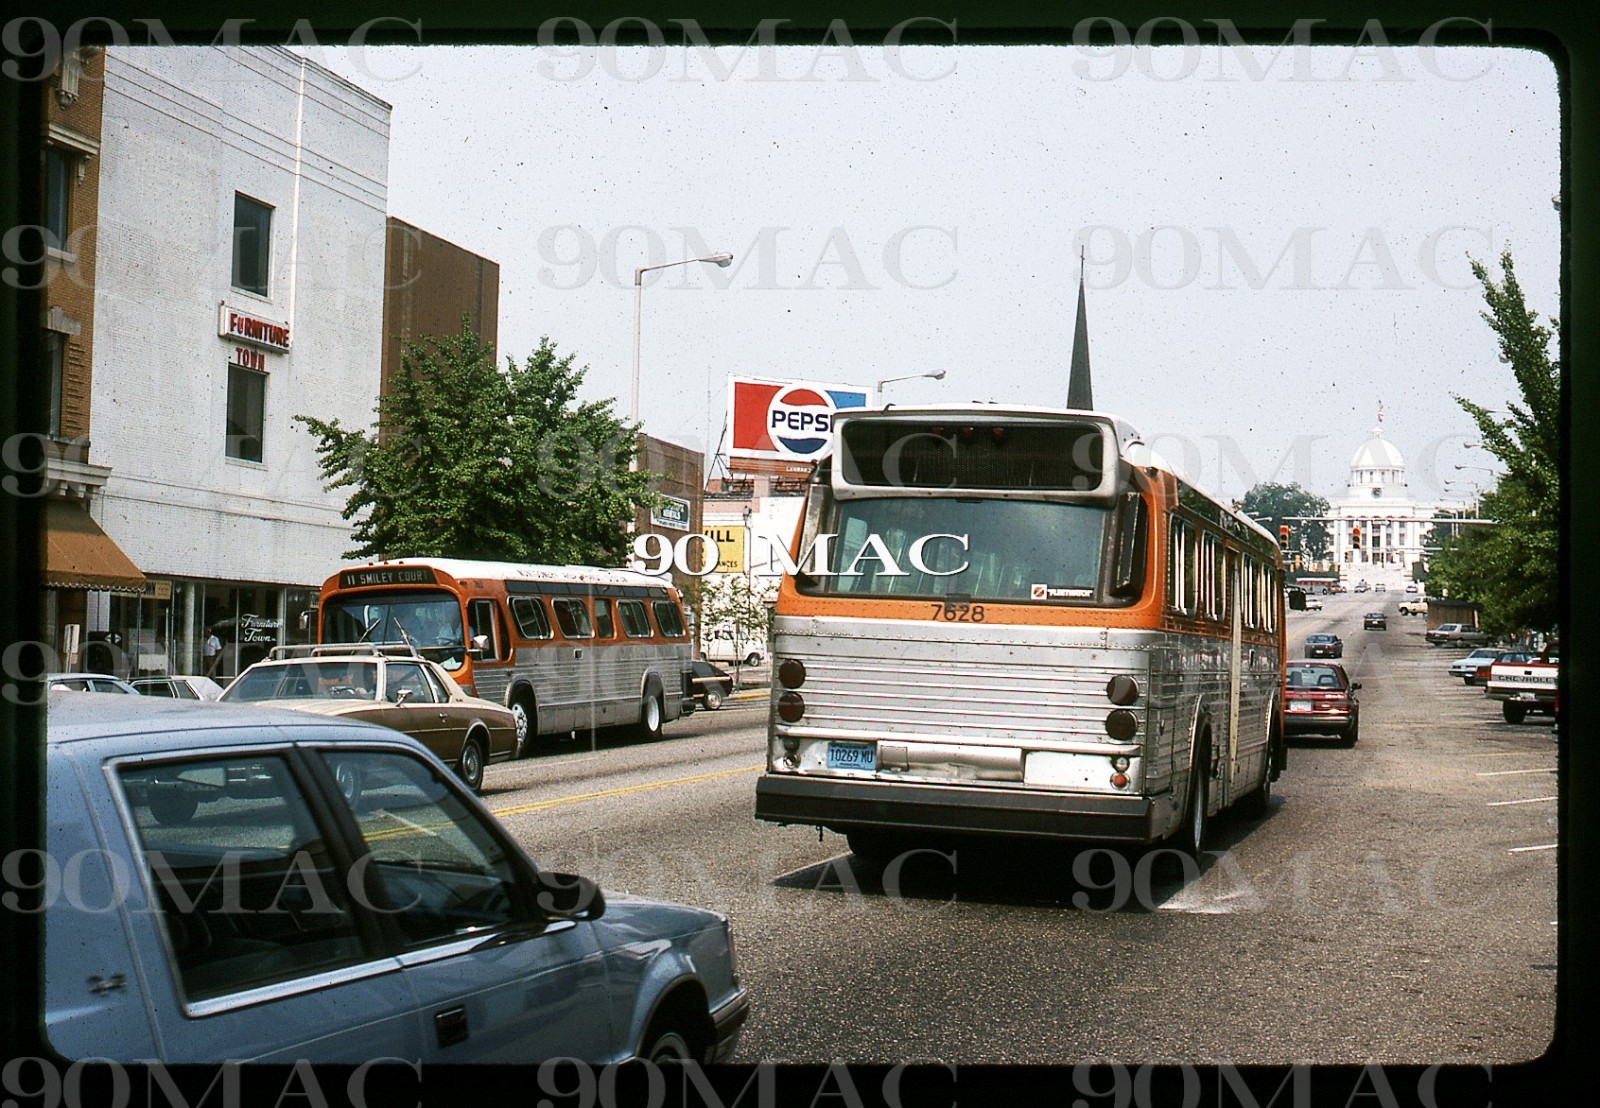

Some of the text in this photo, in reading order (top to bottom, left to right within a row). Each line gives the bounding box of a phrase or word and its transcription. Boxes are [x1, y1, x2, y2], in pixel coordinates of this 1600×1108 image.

[230, 312, 290, 348] FURNITURE
[236, 347, 265, 372] TOWN
[771, 409, 835, 434] PEPSI
[360, 571, 393, 585] SMILEY
[398, 569, 429, 583] COURT
[931, 603, 985, 623] 7628
[244, 627, 271, 642] Town
[1498, 674, 1557, 684] CHEVROLE
[830, 748, 859, 763] 10269
